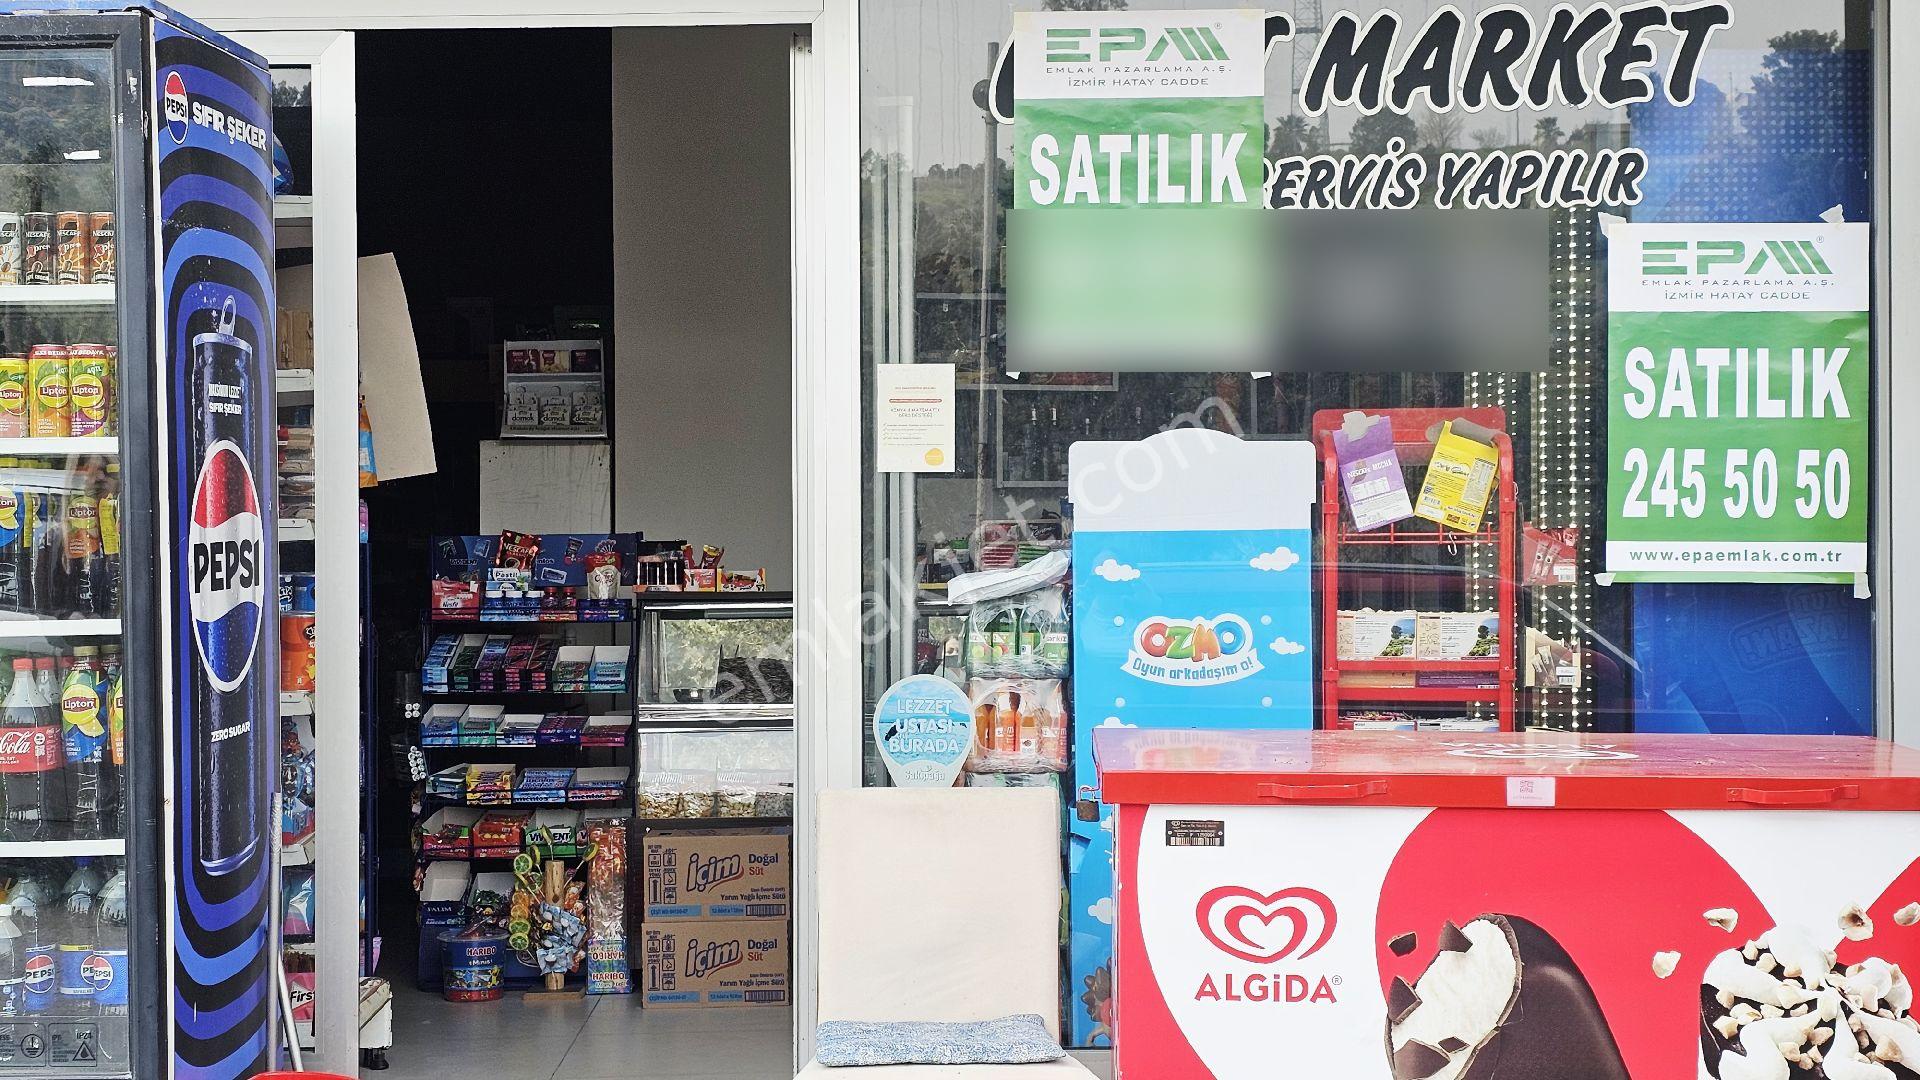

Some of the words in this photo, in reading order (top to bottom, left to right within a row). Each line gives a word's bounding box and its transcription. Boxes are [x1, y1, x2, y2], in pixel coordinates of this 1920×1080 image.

[1302, 3, 1732, 114] MARKET
[1046, 66, 1095, 74] EMLAK
[1104, 65, 1193, 73] PAZARLAMA
[1068, 77, 1106, 87] İZMİR
[1112, 78, 1155, 87] HATAY
[1161, 78, 1209, 86] CADDE
[165, 96, 187, 118] PEPSI
[227, 116, 266, 151] ŞEKER
[1029, 132, 1248, 205] SATILIK
[1264, 138, 1426, 209] ERVİS
[1436, 149, 1647, 208] YAPILIR
[1665, 289, 1704, 300] İZMİR
[1710, 291, 1753, 300] HATAY
[1760, 291, 1810, 300] CADDE
[72, 385, 99, 396] Lipton
[1624, 347, 1851, 419] SATILIK
[42, 386, 67, 397] Lipton
[1623, 448, 1706, 519] 245
[1723, 448, 1778, 519] 50
[1795, 448, 1851, 519] 50
[1629, 549, 1842, 564] www.epaemlak.com.tr
[193, 540, 261, 596] PEPSI
[1141, 620, 1246, 662] OZMO
[1132, 657, 1165, 676] Oyun
[1169, 663, 1238, 680] arkadaşım
[64, 700, 95, 711] Lipton
[897, 699, 954, 714] LEZZET
[211, 728, 229, 742] ZERO
[229, 721, 251, 738] SUGAR
[895, 718, 954, 734] USTASI
[889, 737, 960, 753] BURADA
[748, 853, 778, 867] Doğal
[748, 866, 764, 876] Süt
[466, 946, 497, 957] HARIBO
[747, 939, 778, 951] Doğal
[747, 952, 763, 961] Süt
[592, 972, 625, 981] HARIBO
